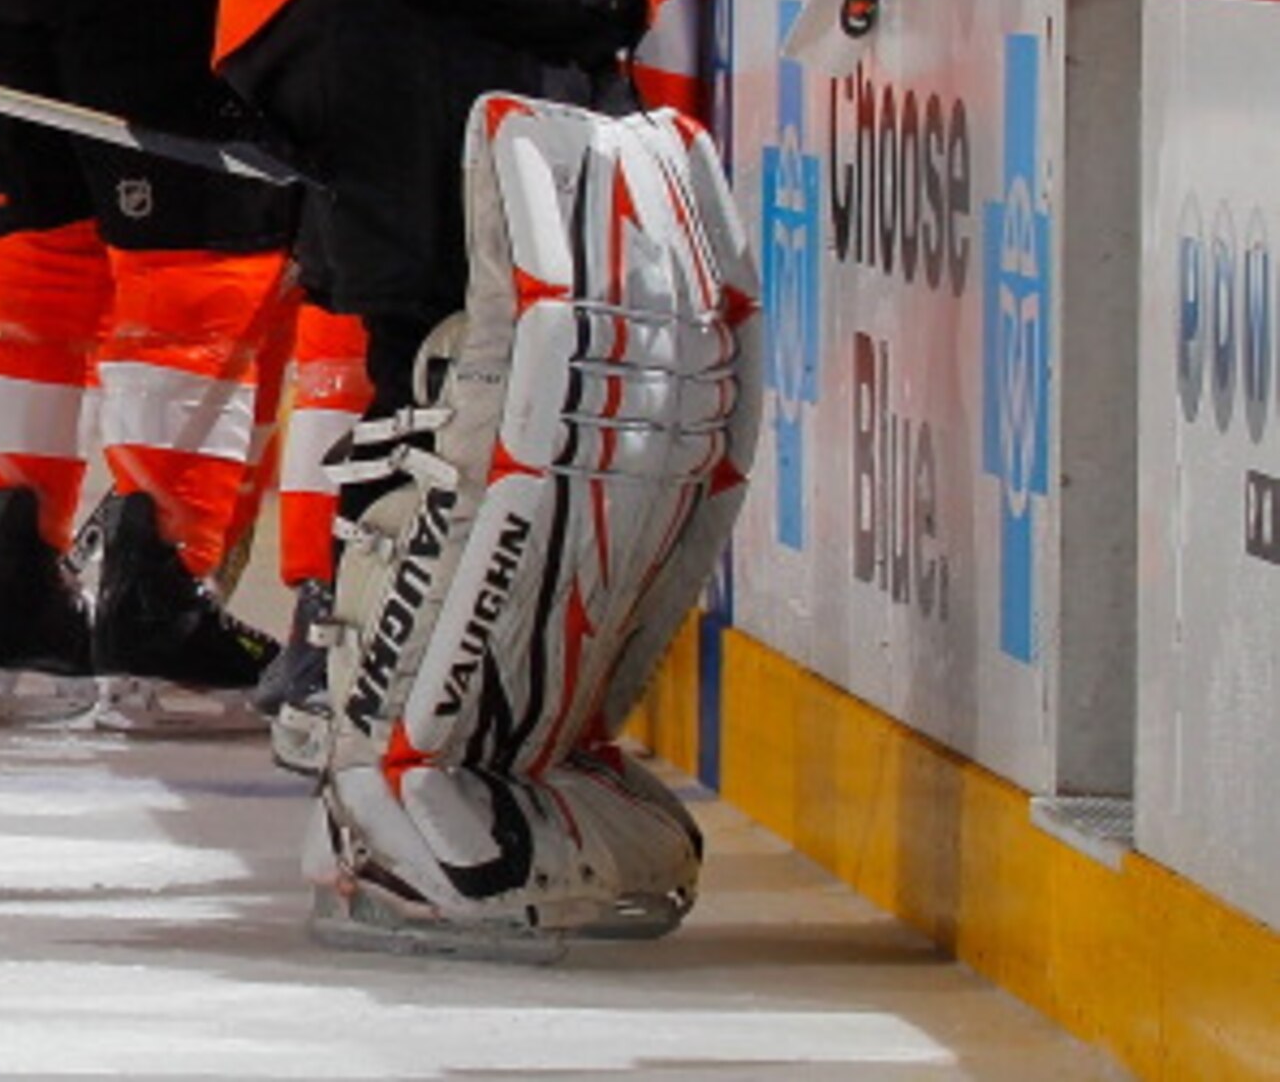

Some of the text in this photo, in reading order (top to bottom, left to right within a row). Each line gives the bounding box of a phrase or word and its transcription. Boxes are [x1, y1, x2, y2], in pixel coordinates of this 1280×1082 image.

[829, 59, 971, 301] Choose
[853, 330, 950, 622] Blue.
[344, 487, 458, 738] VAUGHN
[434, 512, 532, 716] VAUGHN
